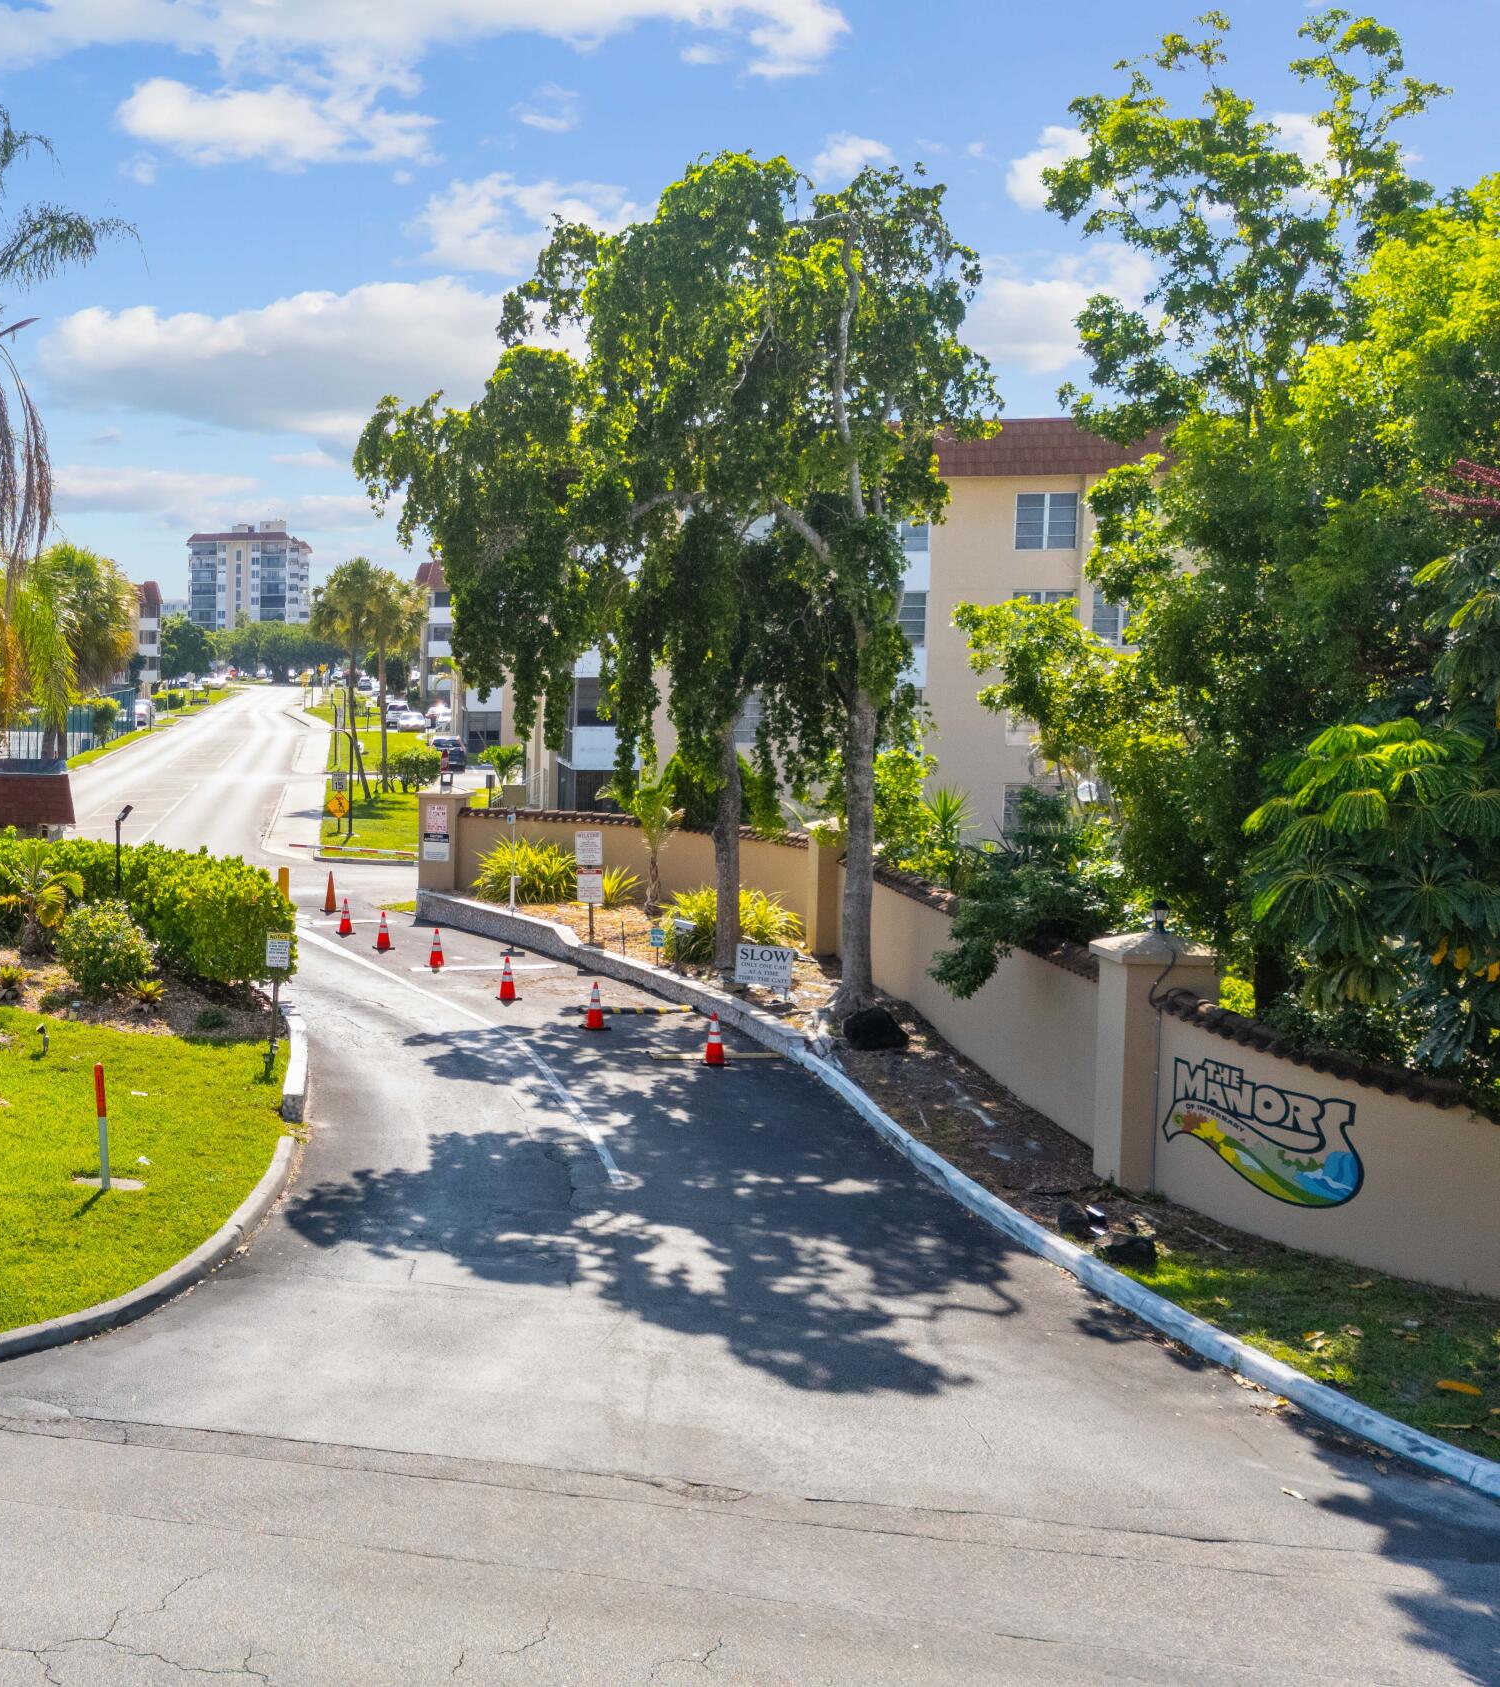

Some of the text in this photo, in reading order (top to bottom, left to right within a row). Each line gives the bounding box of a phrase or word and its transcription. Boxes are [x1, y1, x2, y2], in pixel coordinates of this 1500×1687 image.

[335, 782, 344, 790] 15
[740, 948, 790, 962] SLOW
[1204, 1059, 1244, 1089] THE
[1174, 1057, 1356, 1137] MANORS
[1185, 1102, 1197, 1110] OF
[1197, 1104, 1245, 1133] INVERRARY
